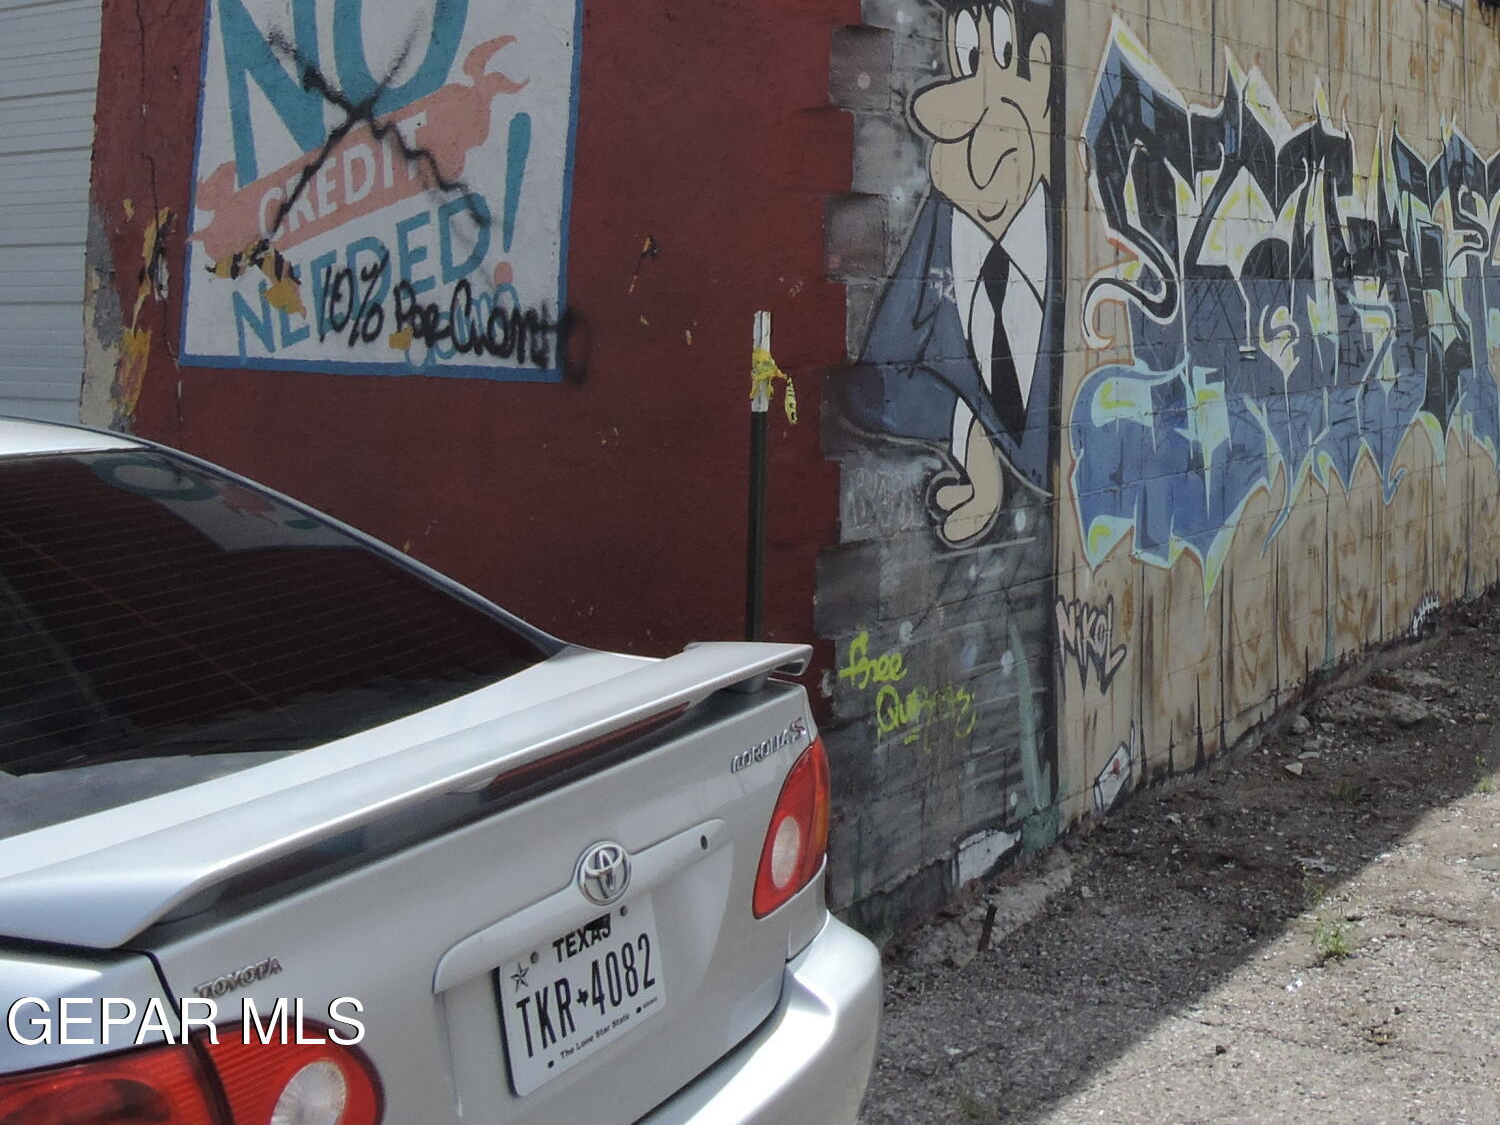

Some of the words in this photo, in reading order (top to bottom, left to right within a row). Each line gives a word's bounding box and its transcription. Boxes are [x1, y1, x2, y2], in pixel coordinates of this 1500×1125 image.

[258, 111, 428, 238] CREDIT
[552, 918, 611, 963] TEXAS
[192, 956, 283, 998] TOYOTA
[516, 977, 576, 1058] TKR
[591, 933, 656, 1016] 4082
[560, 1047, 574, 1060] The
[576, 1035, 594, 1050] Lone
[595, 1025, 611, 1039] Star
[612, 1013, 630, 1028] State
